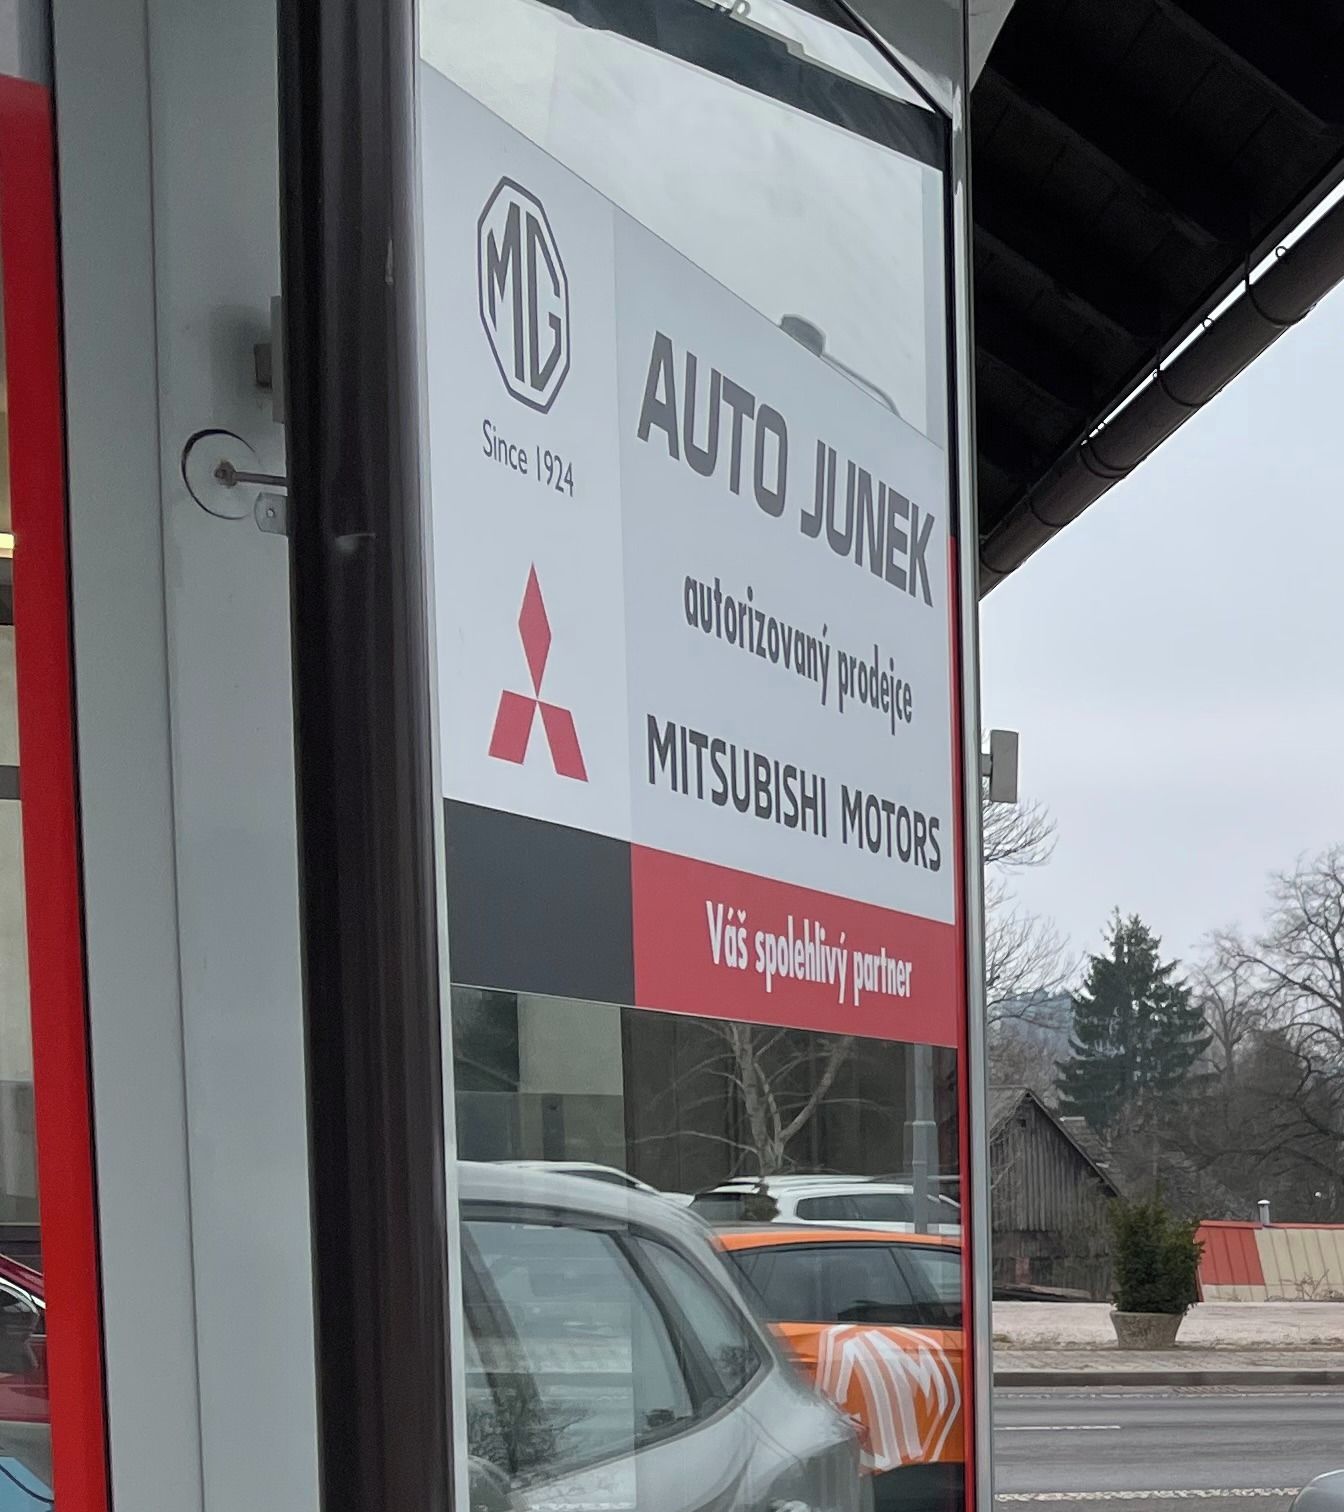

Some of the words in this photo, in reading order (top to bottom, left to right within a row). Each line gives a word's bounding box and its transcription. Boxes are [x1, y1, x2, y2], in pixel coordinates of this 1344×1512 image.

[485, 199, 563, 394] MG
[482, 419, 528, 475] Since
[535, 456, 574, 498] 1924
[636, 330, 789, 518] AUTO
[800, 439, 936, 609] JUNEK
[684, 575, 830, 706] autorizovaný
[838, 644, 913, 736] prodejce
[647, 713, 828, 839] MITSUBISHI
[841, 784, 941, 872] MOTORS
[706, 900, 748, 970] Váš
[755, 914, 848, 1004] spolehlivý
[853, 946, 913, 1006] partner
